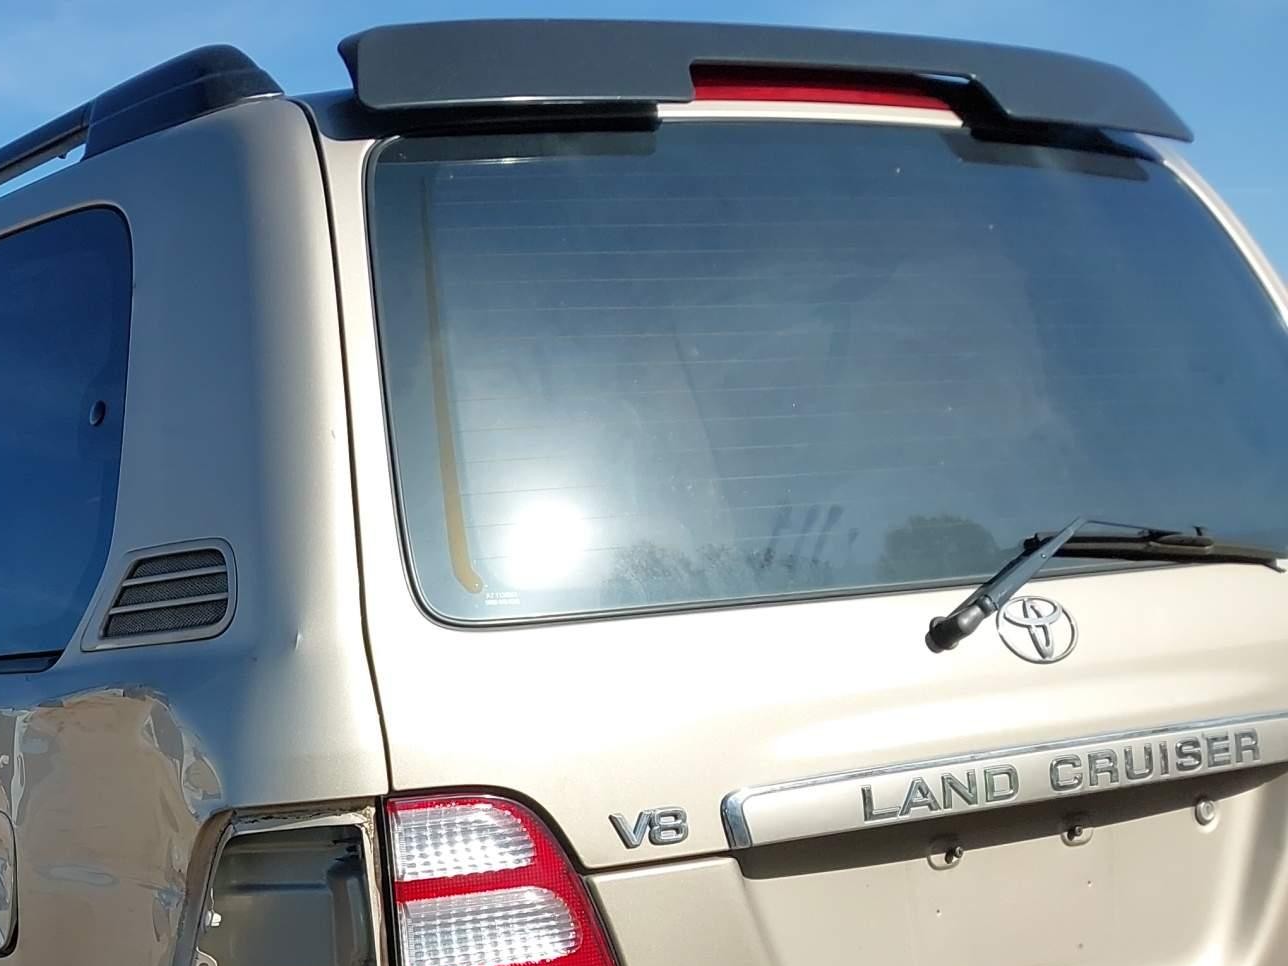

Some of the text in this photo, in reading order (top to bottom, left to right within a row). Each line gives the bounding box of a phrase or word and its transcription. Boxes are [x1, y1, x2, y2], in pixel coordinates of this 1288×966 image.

[861, 727, 1261, 822] LAND CRUISER
[608, 806, 689, 850] V8
